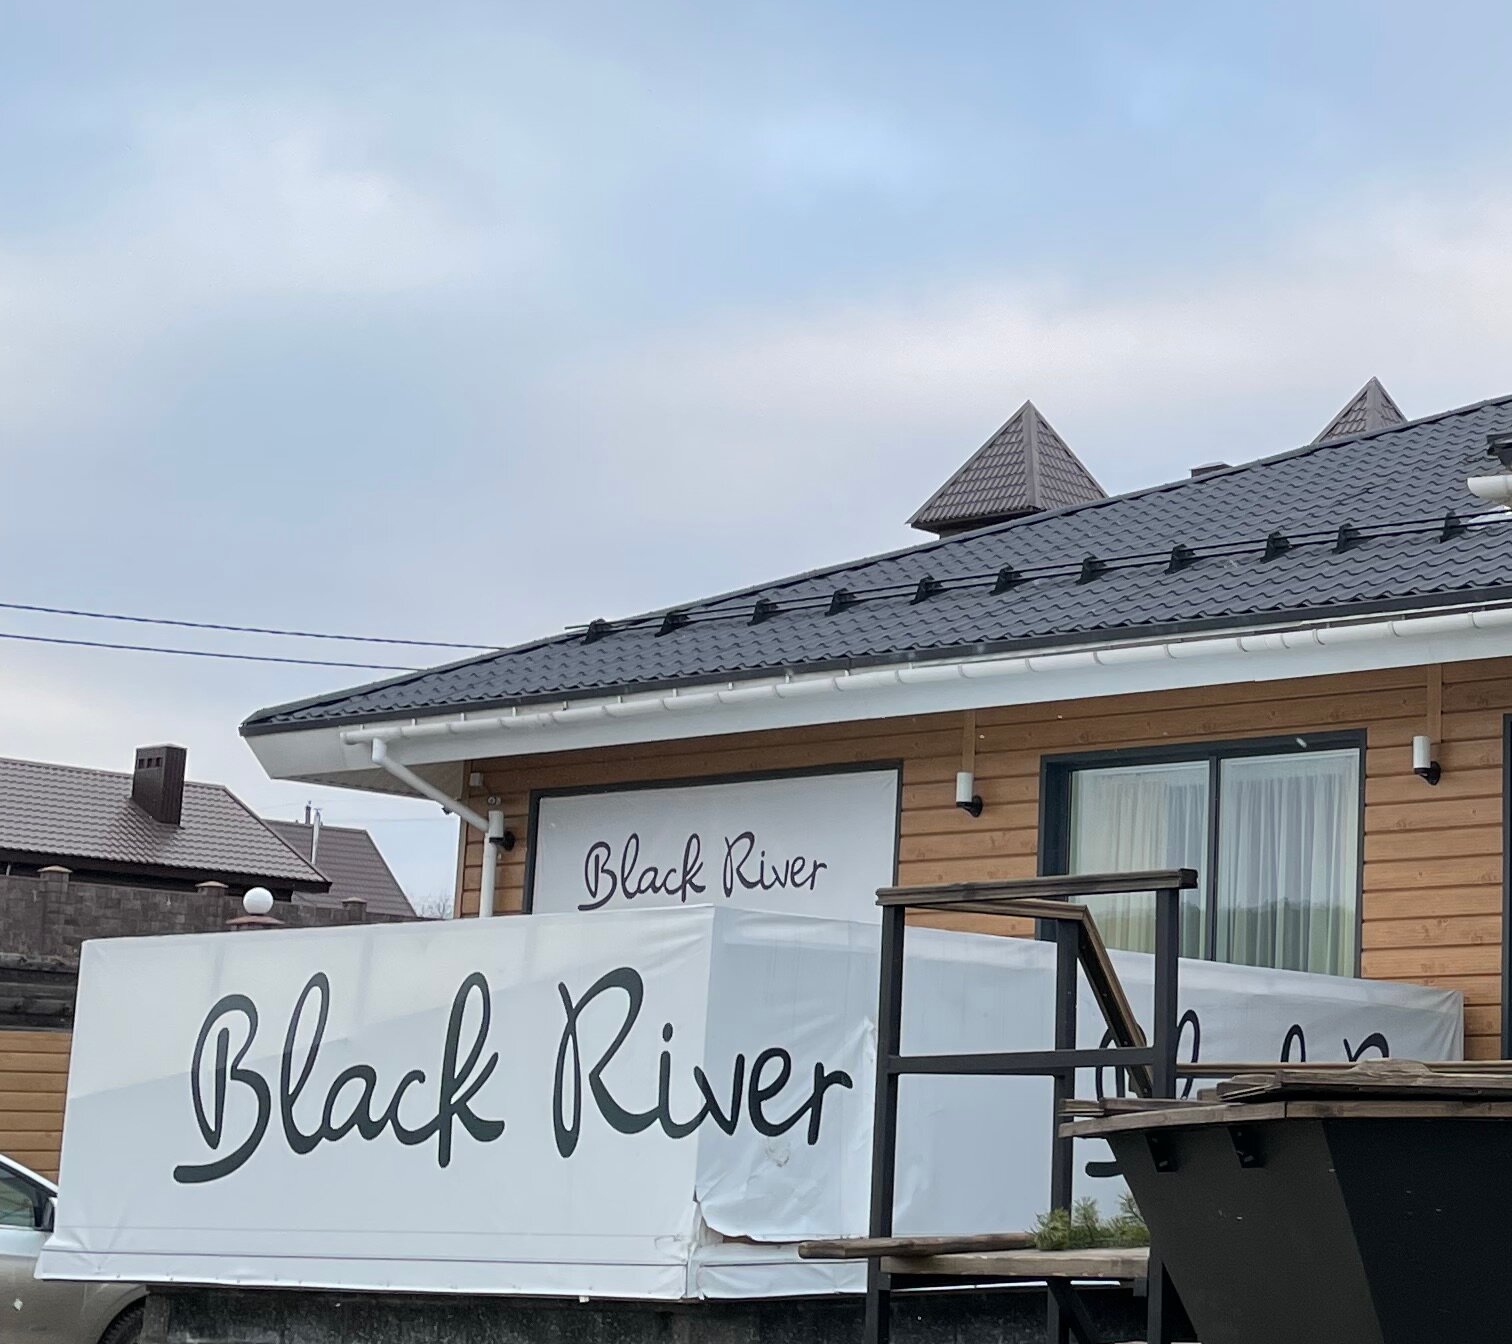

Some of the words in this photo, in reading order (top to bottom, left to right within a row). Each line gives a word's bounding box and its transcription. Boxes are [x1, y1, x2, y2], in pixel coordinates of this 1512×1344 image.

[577, 832, 706, 911] Black
[723, 831, 828, 897] River
[173, 972, 505, 1183] Black
[553, 967, 853, 1158] River
